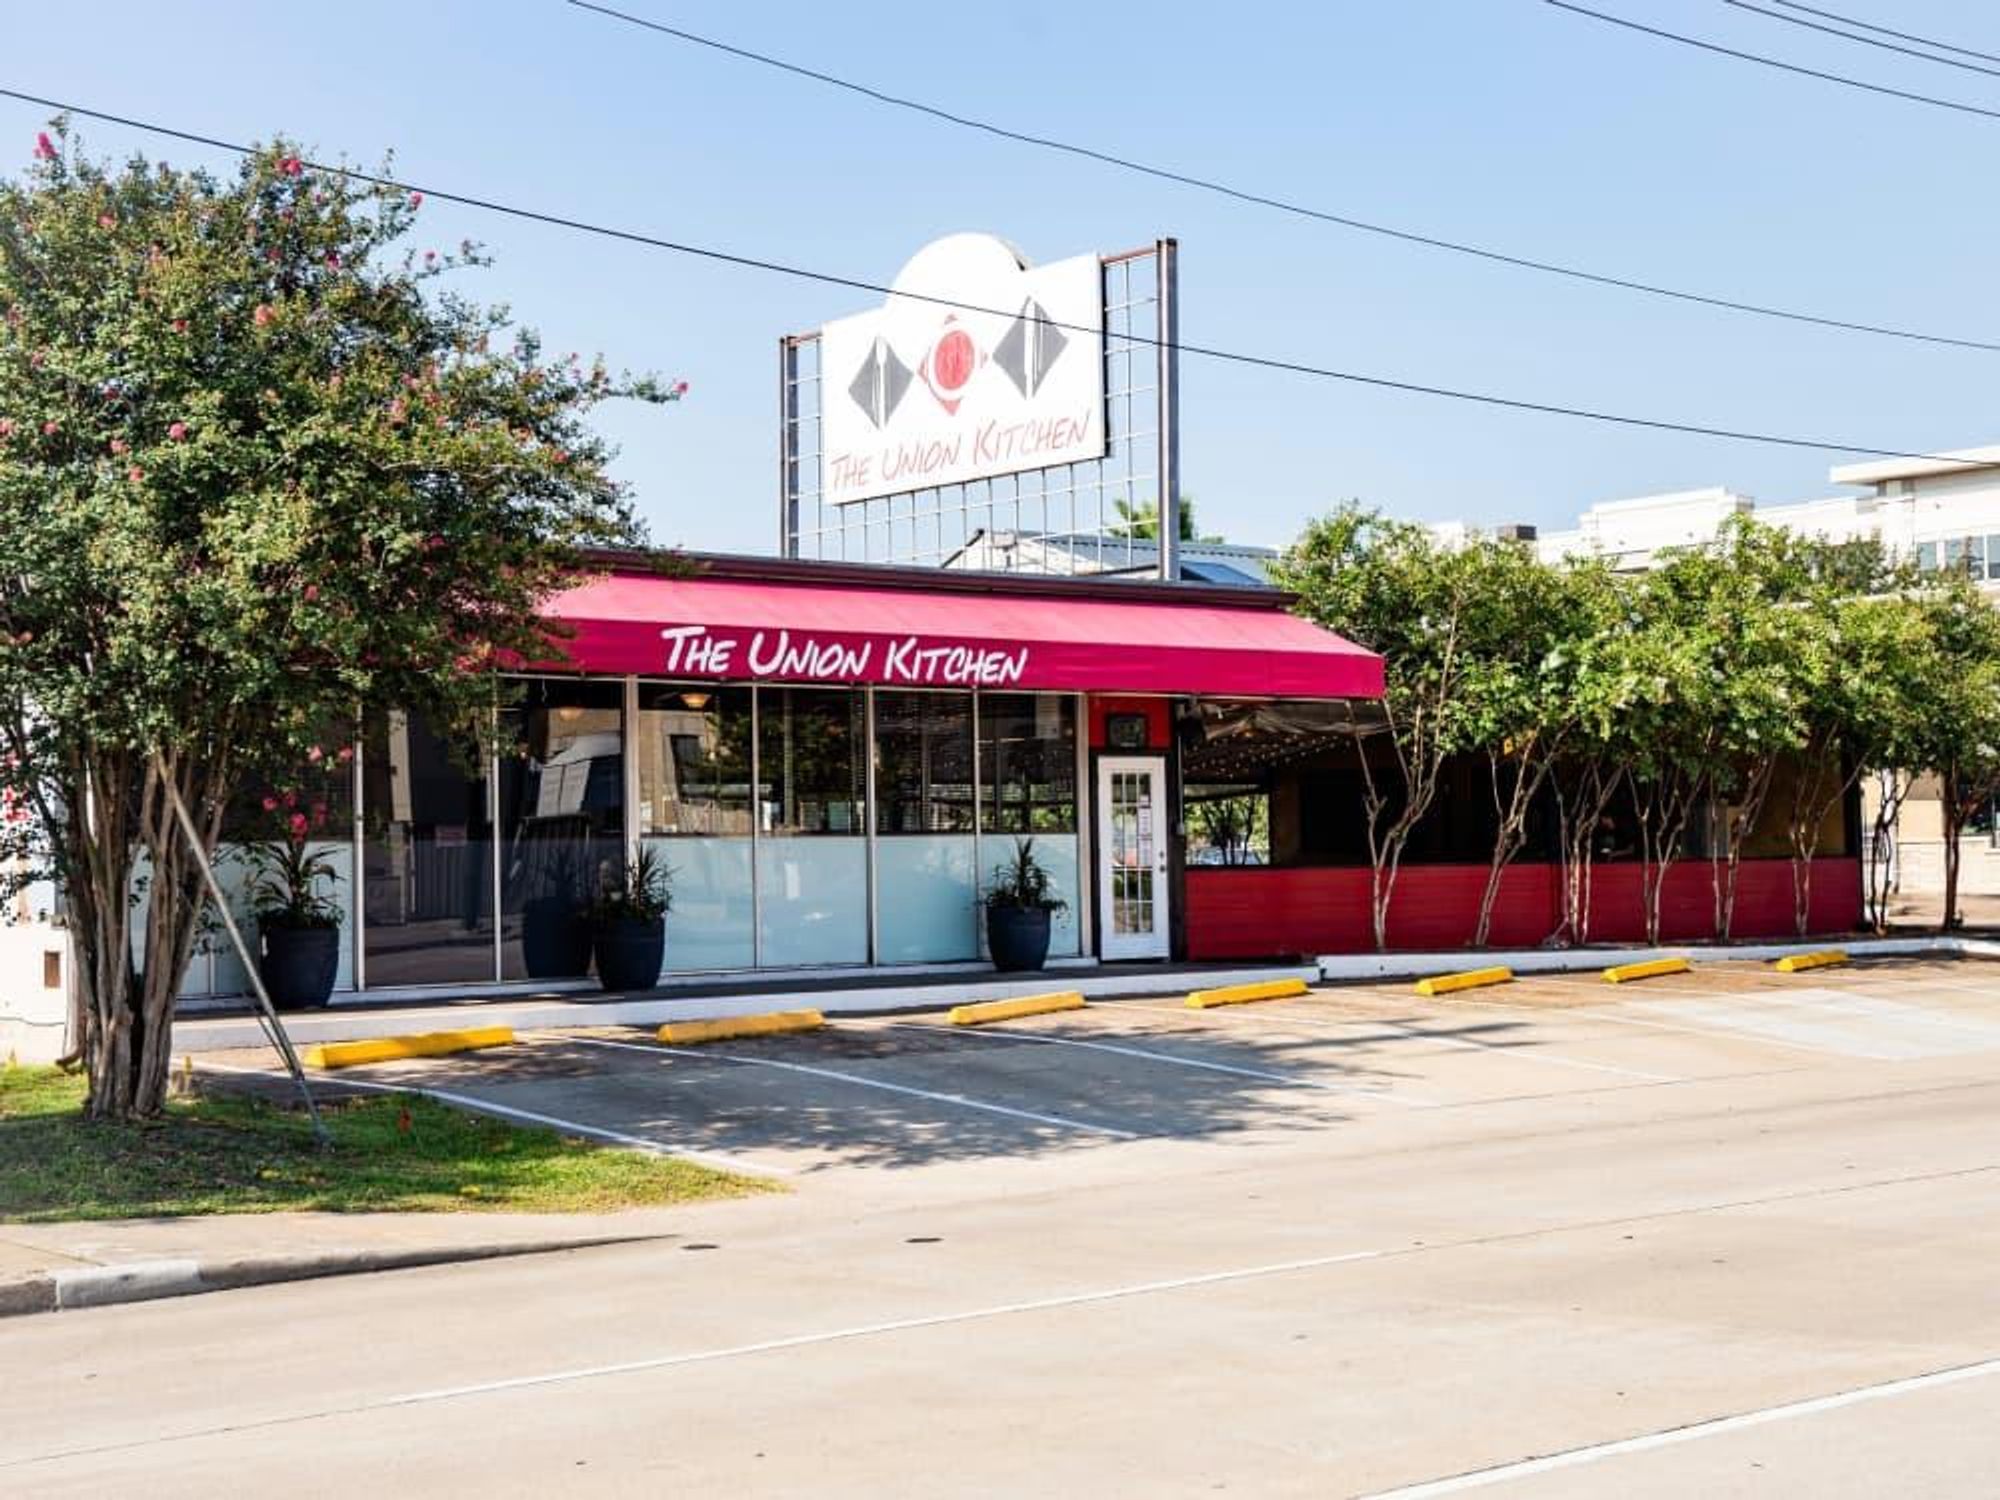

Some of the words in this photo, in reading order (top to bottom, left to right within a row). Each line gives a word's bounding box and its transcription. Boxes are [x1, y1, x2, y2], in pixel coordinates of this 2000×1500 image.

[830, 453, 871, 491] THE
[882, 437, 961, 482] UNION
[973, 410, 1090, 464] KITCHEN
[661, 625, 737, 673] THE
[748, 630, 872, 678] UNION
[884, 637, 1028, 683] KITCHEN
